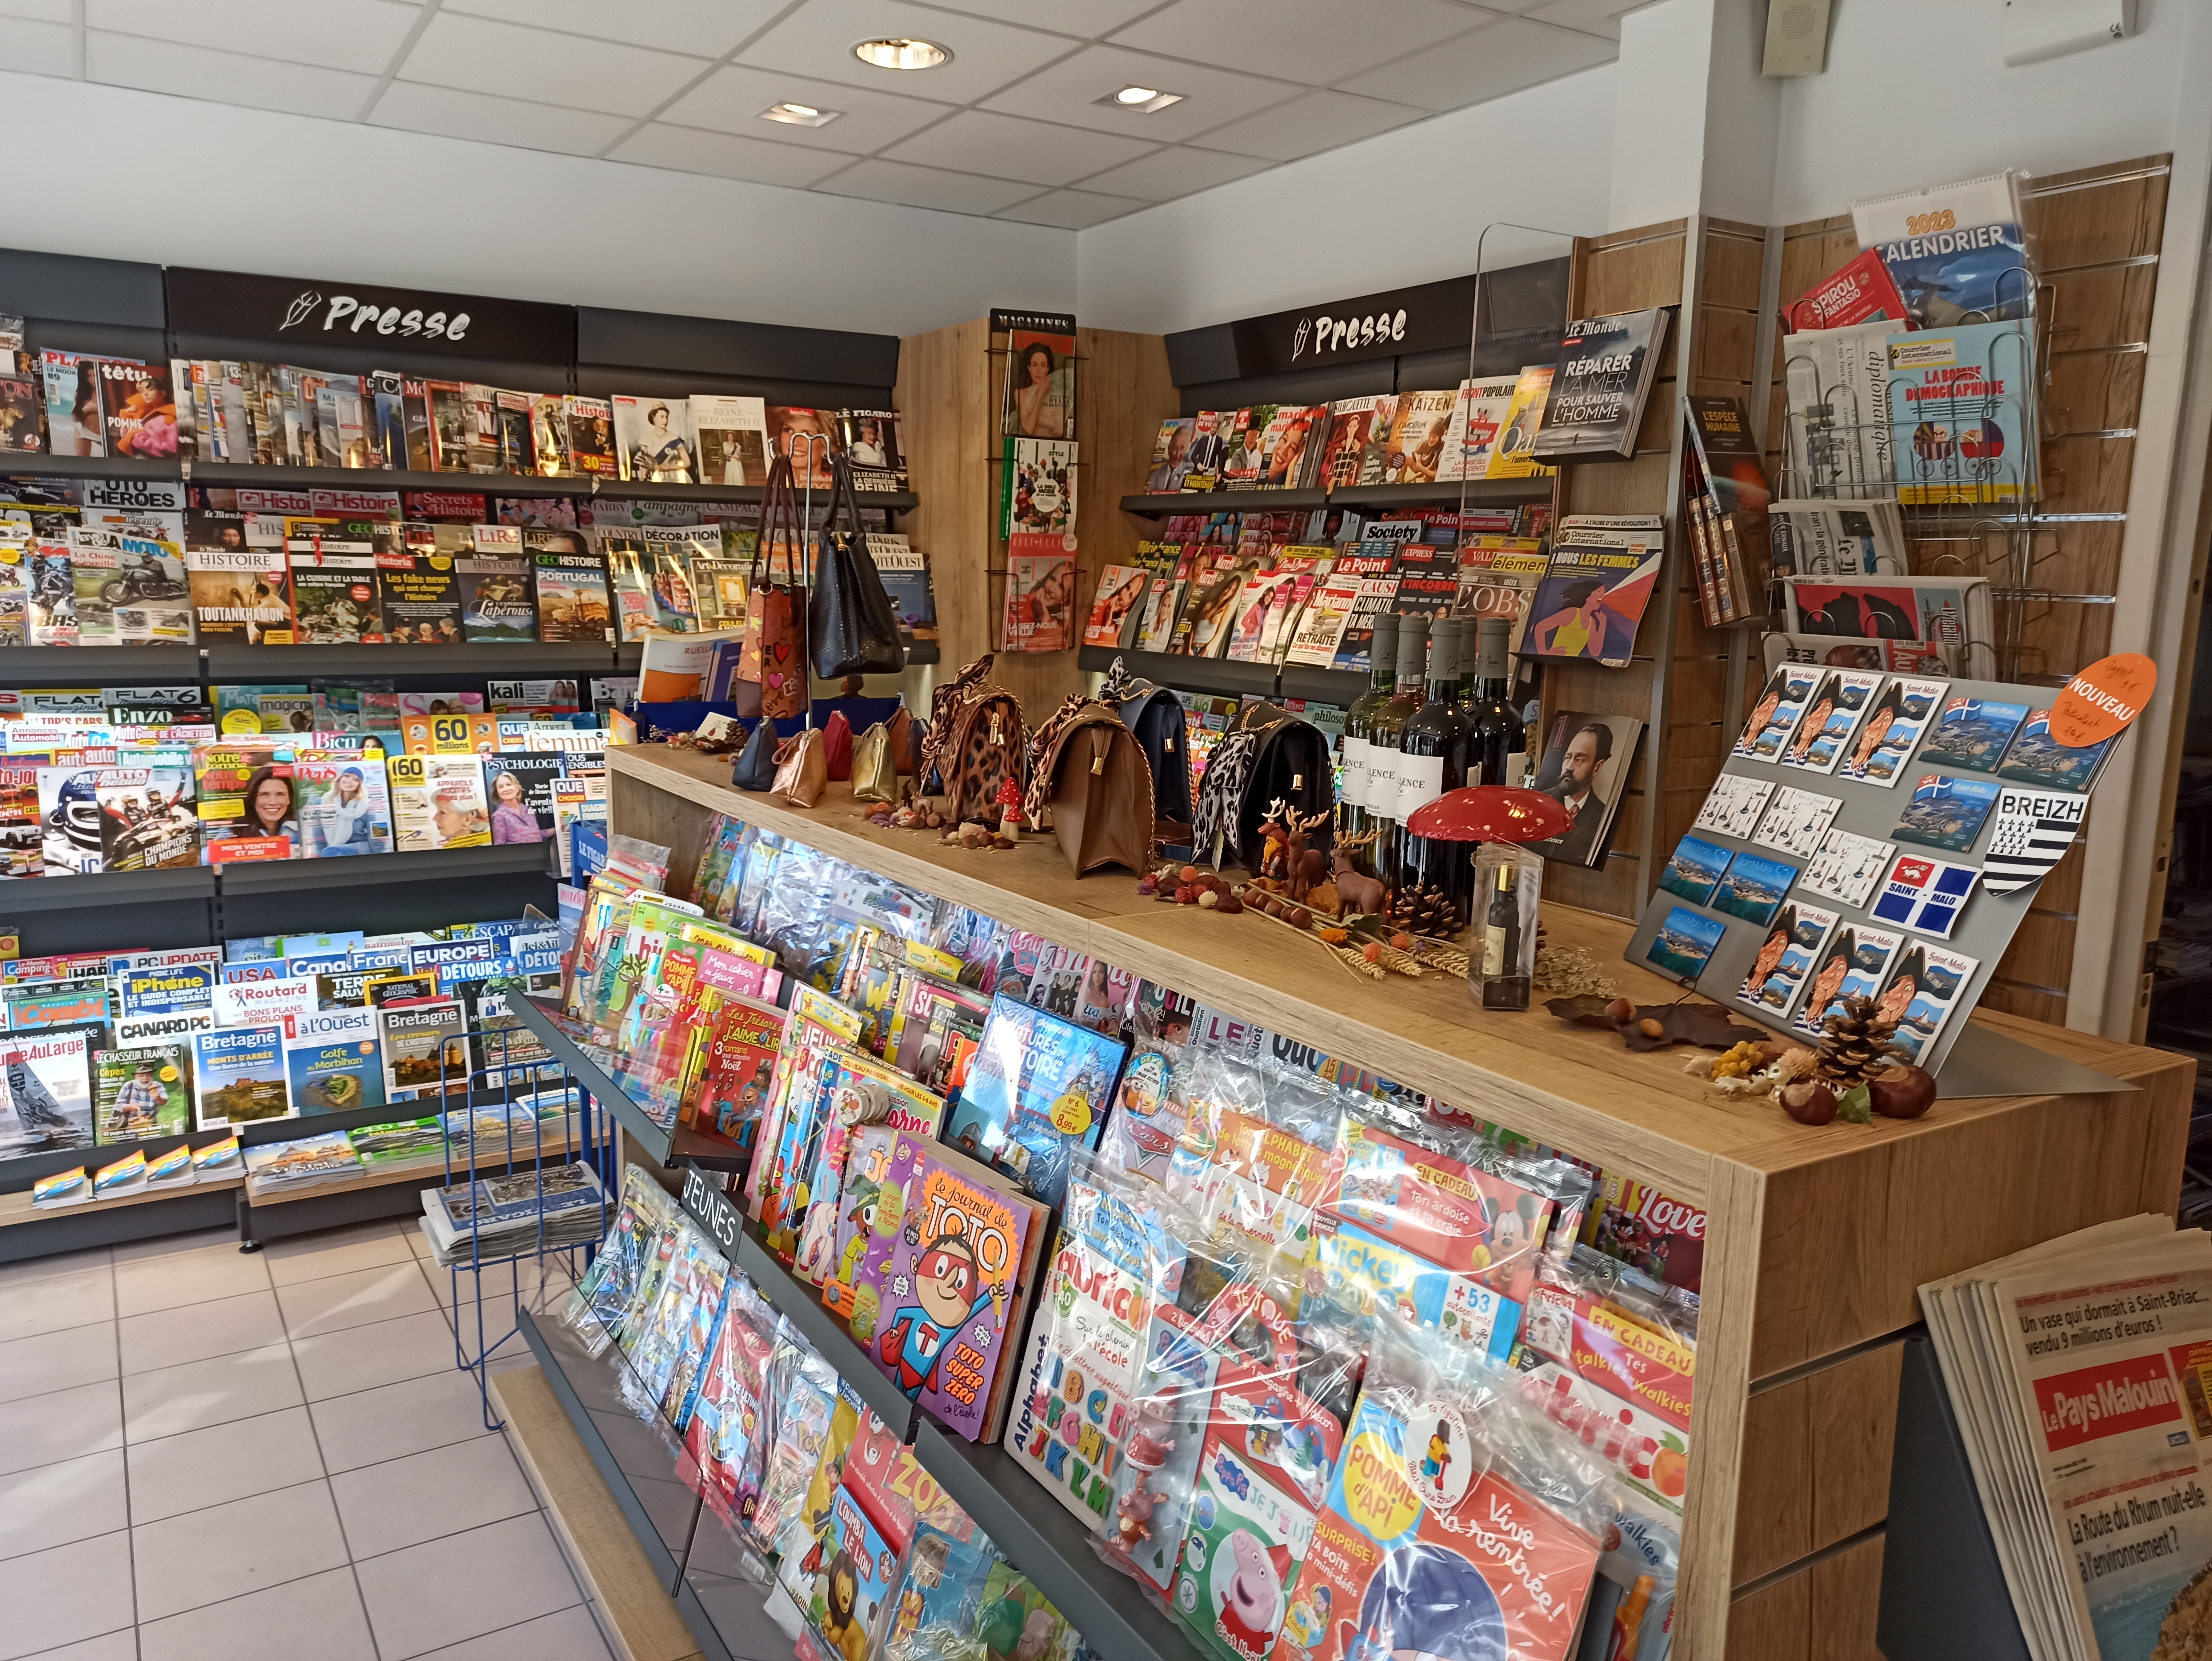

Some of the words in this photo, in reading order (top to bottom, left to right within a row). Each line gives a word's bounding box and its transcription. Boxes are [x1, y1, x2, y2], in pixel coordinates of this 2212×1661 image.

[1907, 210, 1956, 236] 2023
[1811, 276, 1856, 314] SPIROU
[1825, 288, 1861, 319] FANTASIO
[323, 295, 470, 341] Presse
[998, 314, 1069, 329] MAGAZINES
[1315, 309, 1406, 354] Presse
[1567, 324, 1580, 338] Le
[1582, 320, 1622, 335] Monde
[1900, 345, 1931, 354] Courrier
[1901, 349, 1952, 357] international
[1565, 355, 1632, 377] RÉPARER
[1560, 377, 1580, 395] LA
[1588, 372, 1627, 391] MER
[1925, 371, 1939, 385] LA
[1941, 365, 1982, 382] BOMBE
[1557, 394, 1583, 407] POUR
[1586, 392, 1623, 405] SAUVER
[1867, 350, 1887, 462] diplomatique
[853, 410, 892, 419] FIGARO
[1552, 403, 1619, 422] L'HOMME
[108, 416, 143, 430] POMME
[1705, 421, 1741, 432] HUMAINE
[583, 455, 599, 469] 30
[90, 490, 175, 507] HEROES
[423, 493, 473, 505] Secrets
[646, 530, 719, 542] DÉCORATION
[1367, 526, 1418, 542] Society
[1570, 537, 1624, 545] international
[89, 553, 116, 561] Chine
[200, 555, 271, 566] HISTOIRE
[535, 554, 559, 566] GEO
[559, 556, 601, 567] HISTOIRE
[1338, 558, 1350, 571] Le
[1352, 559, 1386, 572] Point
[1555, 552, 1580, 564] NOUS
[1579, 553, 1599, 565] LES
[1597, 554, 1639, 568] FEMMES
[474, 561, 524, 571] HISTOIRE
[386, 574, 400, 583] Les
[402, 574, 424, 583] fake
[538, 571, 604, 583] PORTUGAL
[197, 607, 284, 621] TOUTANKHAMON
[1789, 671, 1817, 679] Saint-Malo
[1843, 676, 1874, 686] Saint-Malo
[116, 690, 174, 699] FLAT
[177, 690, 197, 703] 6
[490, 684, 523, 699] kali
[1905, 684, 1939, 695] Saint-Malo
[2068, 677, 2135, 721] NOUVEAU
[113, 708, 173, 724] Enzo
[1983, 706, 2016, 715] Saint-Malo
[435, 719, 467, 741] 60
[500, 723, 528, 735] QUE
[436, 741, 469, 751] millions
[400, 759, 423, 776] 60
[556, 781, 584, 793] QUE
[557, 794, 586, 802] CHOISIR
[2002, 795, 2084, 821] BREIZH
[1889, 883, 1919, 897] SAINT
[1930, 893, 1956, 906] MALO
[1799, 908, 1830, 925] Saint-Malo
[1857, 931, 1894, 947] Saint-Malo
[160, 952, 219, 966] UPDATE
[414, 945, 490, 963] EUROPE
[1927, 952, 1967, 972] Saint-Malo
[8, 963, 51, 976] Camping
[442, 961, 503, 980] DÉTOURS
[707, 952, 723, 971] Mon
[724, 960, 755, 980] cahier
[229, 968, 277, 983] USA
[141, 991, 166, 1000] GUIDE
[169, 987, 211, 997] COMPLET
[141, 993, 210, 1006] INDISPENSABLE
[245, 985, 307, 1000] Routard
[244, 1007, 270, 1017] BONS
[272, 1005, 303, 1015] PLANS
[388, 1009, 458, 1029] Bretagne
[121, 1018, 189, 1039] CANARD
[190, 1016, 210, 1031] PC
[300, 1022, 308, 1034] à
[310, 1013, 369, 1033] l'Ouest
[201, 1032, 277, 1051] Bretagne
[714, 1041, 723, 1055] 3
[723, 1045, 748, 1055] romans
[104, 1051, 142, 1063] CHASSEUR
[207, 1055, 238, 1065] MONTS
[321, 1047, 348, 1058] Golfe
[315, 1056, 363, 1070] Morbihan
[720, 1059, 741, 1071] Noël
[1416, 1165, 1431, 1183] EN
[1433, 1171, 1478, 1200] CADEAU
[684, 1169, 736, 1246] JEUNES
[934, 1177, 946, 1191] le
[945, 1186, 993, 1222] journal
[995, 1212, 1007, 1230] de
[1430, 1198, 1471, 1225] ardoise
[927, 1194, 1008, 1273] TOTO
[1446, 1300, 1492, 1328] autocollants
[2020, 1315, 2037, 1333] Un
[2039, 1313, 2063, 1330] vase
[2066, 1306, 2082, 1327] qui
[2084, 1298, 2127, 1322] dormait
[2128, 1297, 2136, 1313] à
[1591, 1314, 1615, 1334] EN
[1620, 1327, 1692, 1373] CADEAU
[2026, 1333, 2060, 1356] vendu
[2061, 1332, 2068, 1348] 9
[2071, 1326, 2112, 1347] millions
[2115, 1319, 2155, 1338] d'euros
[954, 1342, 985, 1369] TOTO
[1625, 1352, 1647, 1373] Tes
[945, 1357, 984, 1391] SUPER
[945, 1378, 975, 1405] ZÉRO
[1574, 1349, 1692, 1417] talkies-walkies
[2042, 1410, 2059, 1433] Le
[2053, 1391, 2101, 1434] Pays
[2096, 1368, 2178, 1418] Malouin
[1348, 1441, 1418, 1513] POMME
[839, 1498, 865, 1543] LOUMBA
[2067, 1517, 2081, 1546] La
[2080, 1511, 2113, 1540] Route
[2113, 1501, 2131, 1529] du
[2127, 1495, 2163, 1526] Rhum
[2162, 1480, 2206, 1515] nuit-elle
[1488, 1492, 1536, 1552] Vive
[1311, 1534, 1324, 1553] TA
[1613, 1511, 1660, 1567] walkies
[843, 1534, 854, 1554] LE
[852, 1548, 872, 1579] LION
[1464, 1518, 1556, 1610] rentrée
[2079, 1554, 2088, 1583] à
[2086, 1530, 2172, 1580] l'environnement
[1313, 1554, 1358, 1599] mini-défis
